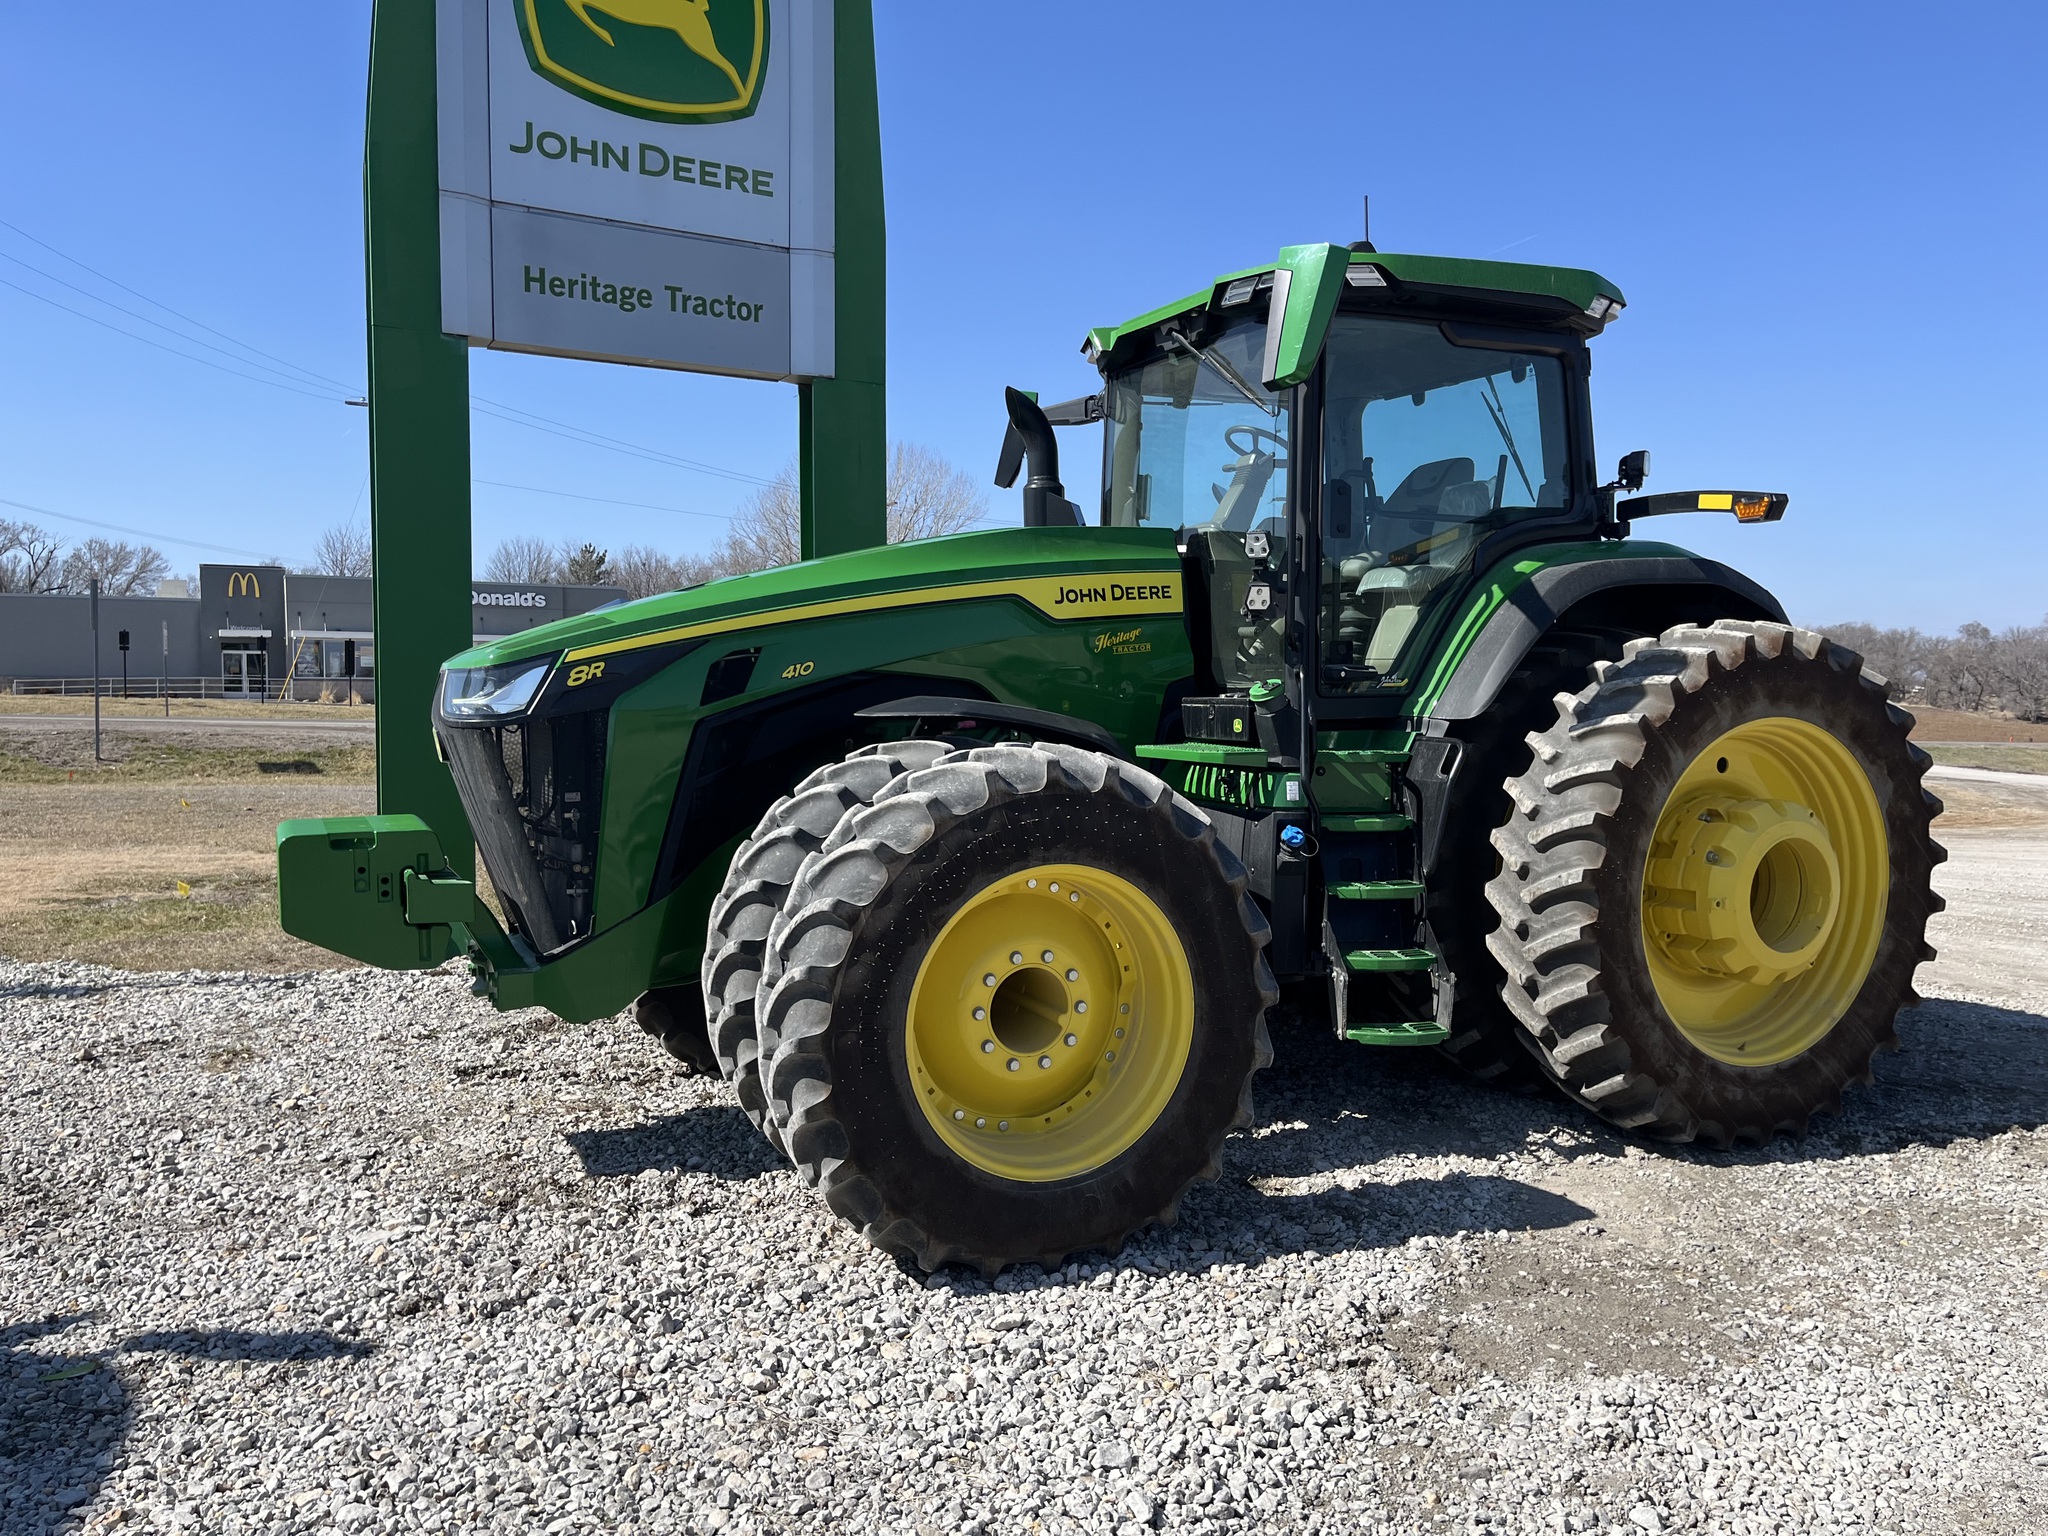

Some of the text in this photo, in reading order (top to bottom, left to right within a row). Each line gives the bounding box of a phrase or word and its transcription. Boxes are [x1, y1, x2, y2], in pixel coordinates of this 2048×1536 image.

[510, 121, 774, 197] JOHN DEERE
[523, 265, 764, 323] Heritage Tractor
[1055, 584, 1172, 604] JOHN DEERE
[1094, 627, 1142, 653] Heritage
[1112, 644, 1151, 653] TRACTOR
[567, 661, 605, 687] 8R
[781, 661, 815, 679] 410
